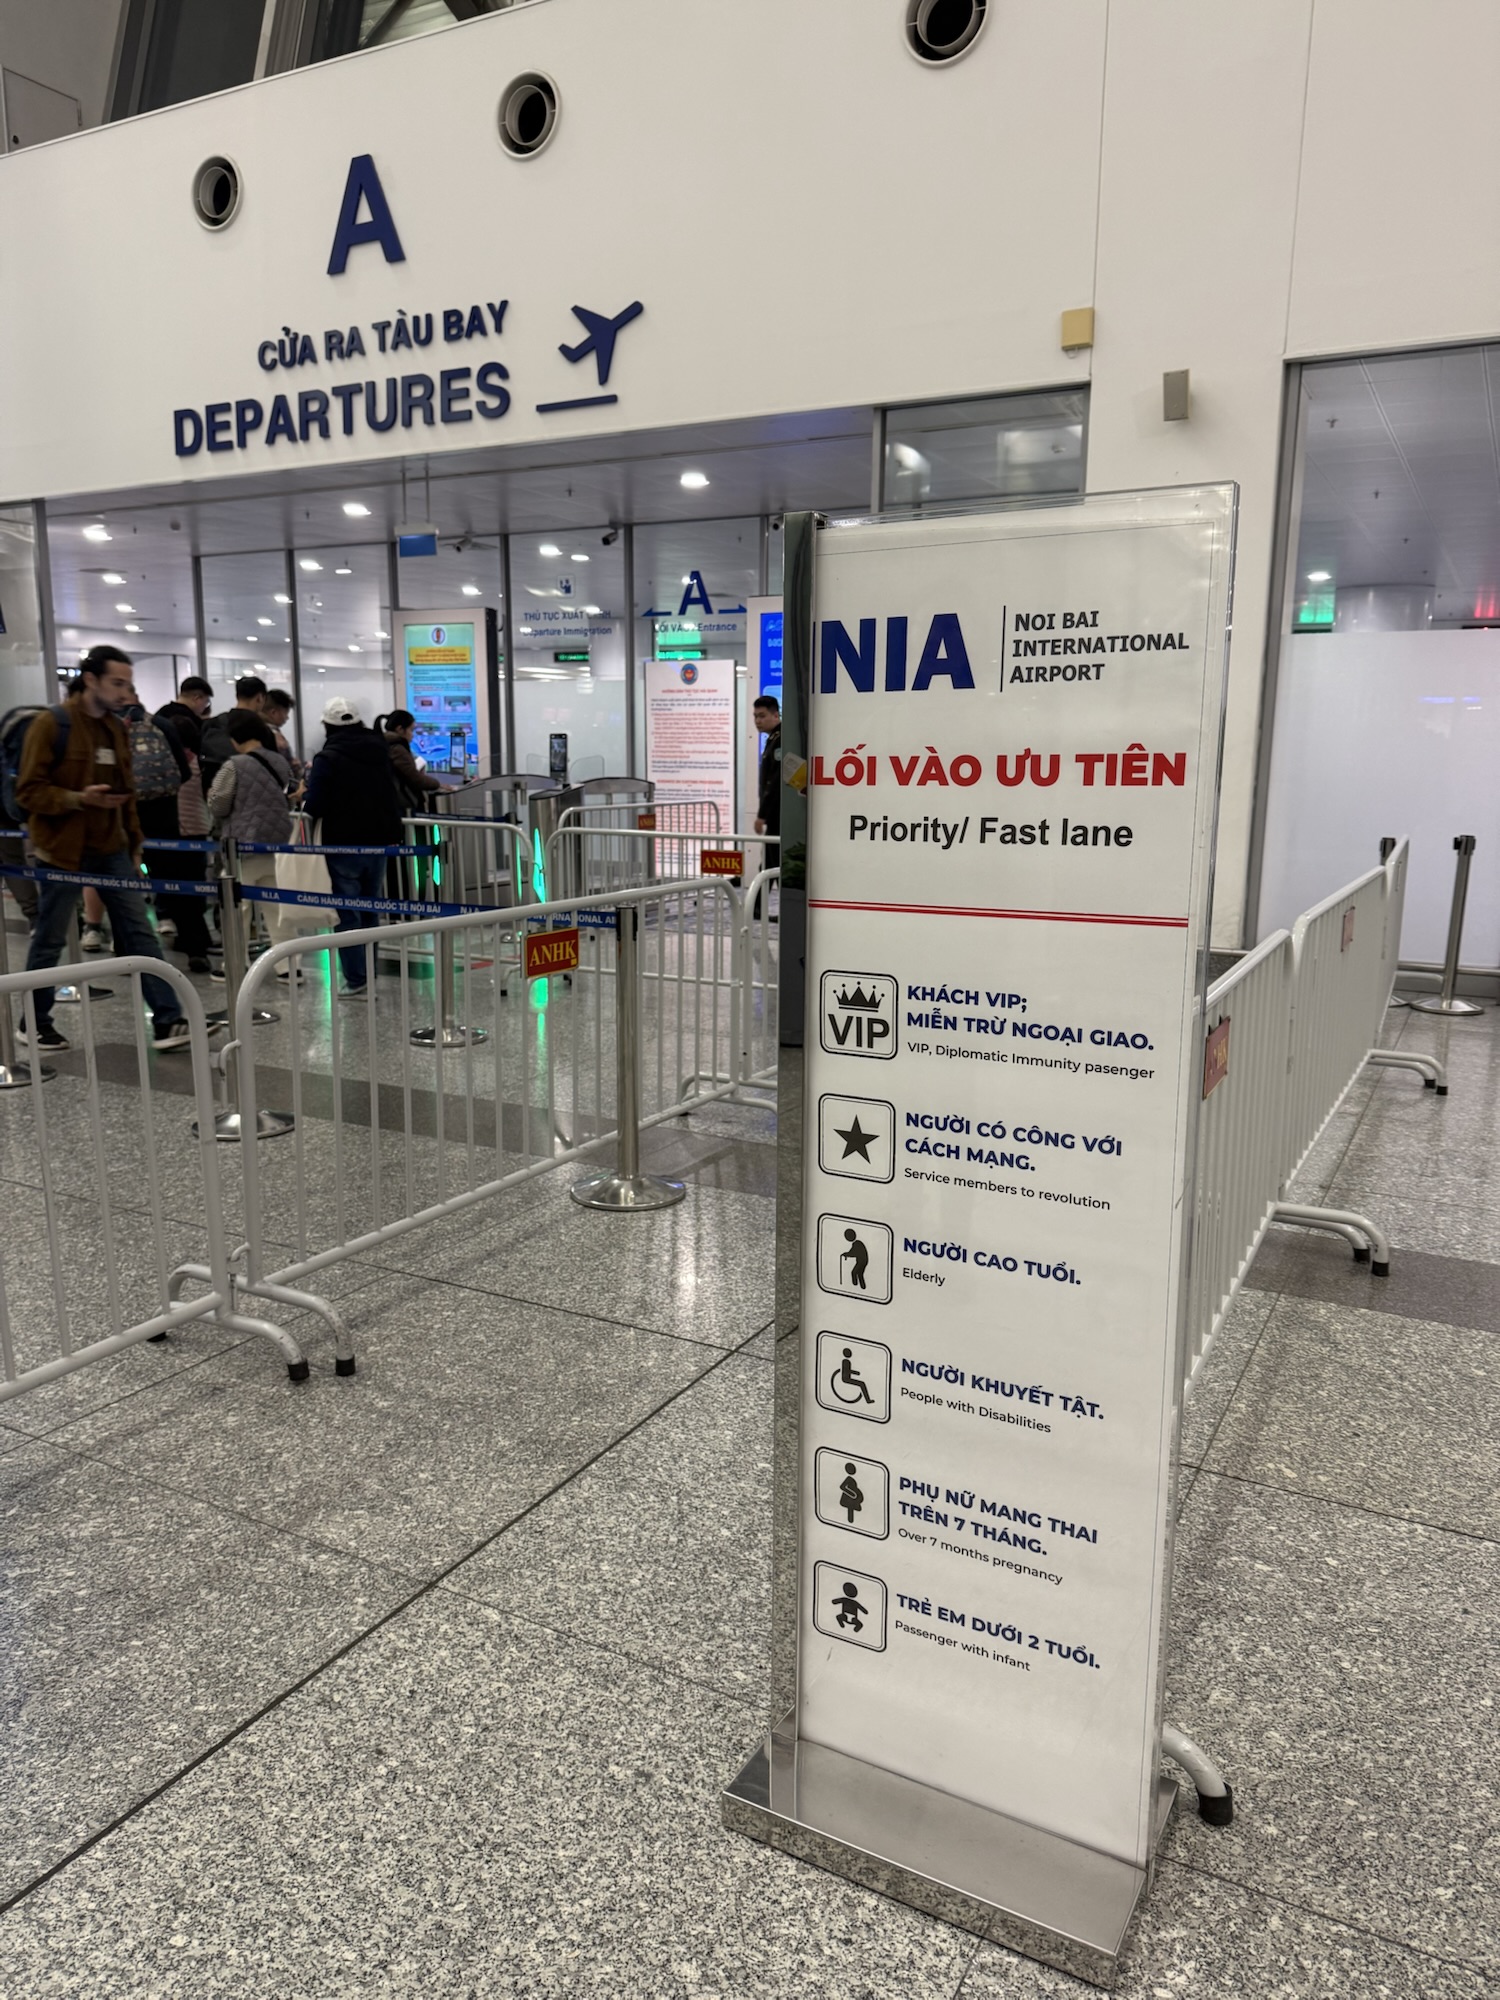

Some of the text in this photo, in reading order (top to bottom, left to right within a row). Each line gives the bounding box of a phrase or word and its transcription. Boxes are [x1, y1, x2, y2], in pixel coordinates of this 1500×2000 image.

[327, 153, 406, 276] A
[258, 300, 509, 371] CỬA RA TÀU BAY
[173, 361, 511, 456] DEPARTURES
[678, 570, 714, 616] A
[698, 623, 738, 633] Entrance
[1014, 610, 1099, 632] NOI BAI
[820, 613, 976, 694] NIA
[1012, 633, 1190, 658] INTERNATIONAL
[1010, 663, 1105, 684] AIRPORT
[814, 743, 1187, 787] LỐI VÀO ƯU TIÊN
[849, 815, 1133, 850] Priority/ Fast lane
[704, 857, 741, 870] ANHK
[530, 940, 577, 967] ANHK
[907, 985, 1027, 1013] KHÁCH VIP;
[828, 1014, 890, 1048] VIP
[907, 1007, 1154, 1050] MIỄN TRỪ NGOẠI GIAO.
[908, 1042, 1155, 1079] VIP, Diplomatic Immunity pasenger
[905, 1137, 1035, 1171] CÁCH MẠNG.
[906, 1112, 1122, 1155] NGƯỜI CÓ CÔNG VỚI
[904, 1167, 1110, 1210] Service members to revolution
[903, 1237, 1081, 1285] NGƯỜI CAO TUỔI.
[903, 1268, 945, 1287] Elderly
[901, 1387, 1051, 1433] People with Disabilities
[902, 1358, 1104, 1420] NGƯỜI KHUYẾT TẬT.
[899, 1476, 1098, 1544] PHỤ NỮ MANG THAI
[899, 1501, 1047, 1555] TRÊN 7 THÁNG.
[898, 1528, 1063, 1585] Over 7 months pregnancy
[895, 1620, 1031, 1671] Passenger with infant
[896, 1594, 1101, 1669] TRẺ EM DƯỚI 2 TUỔI.
